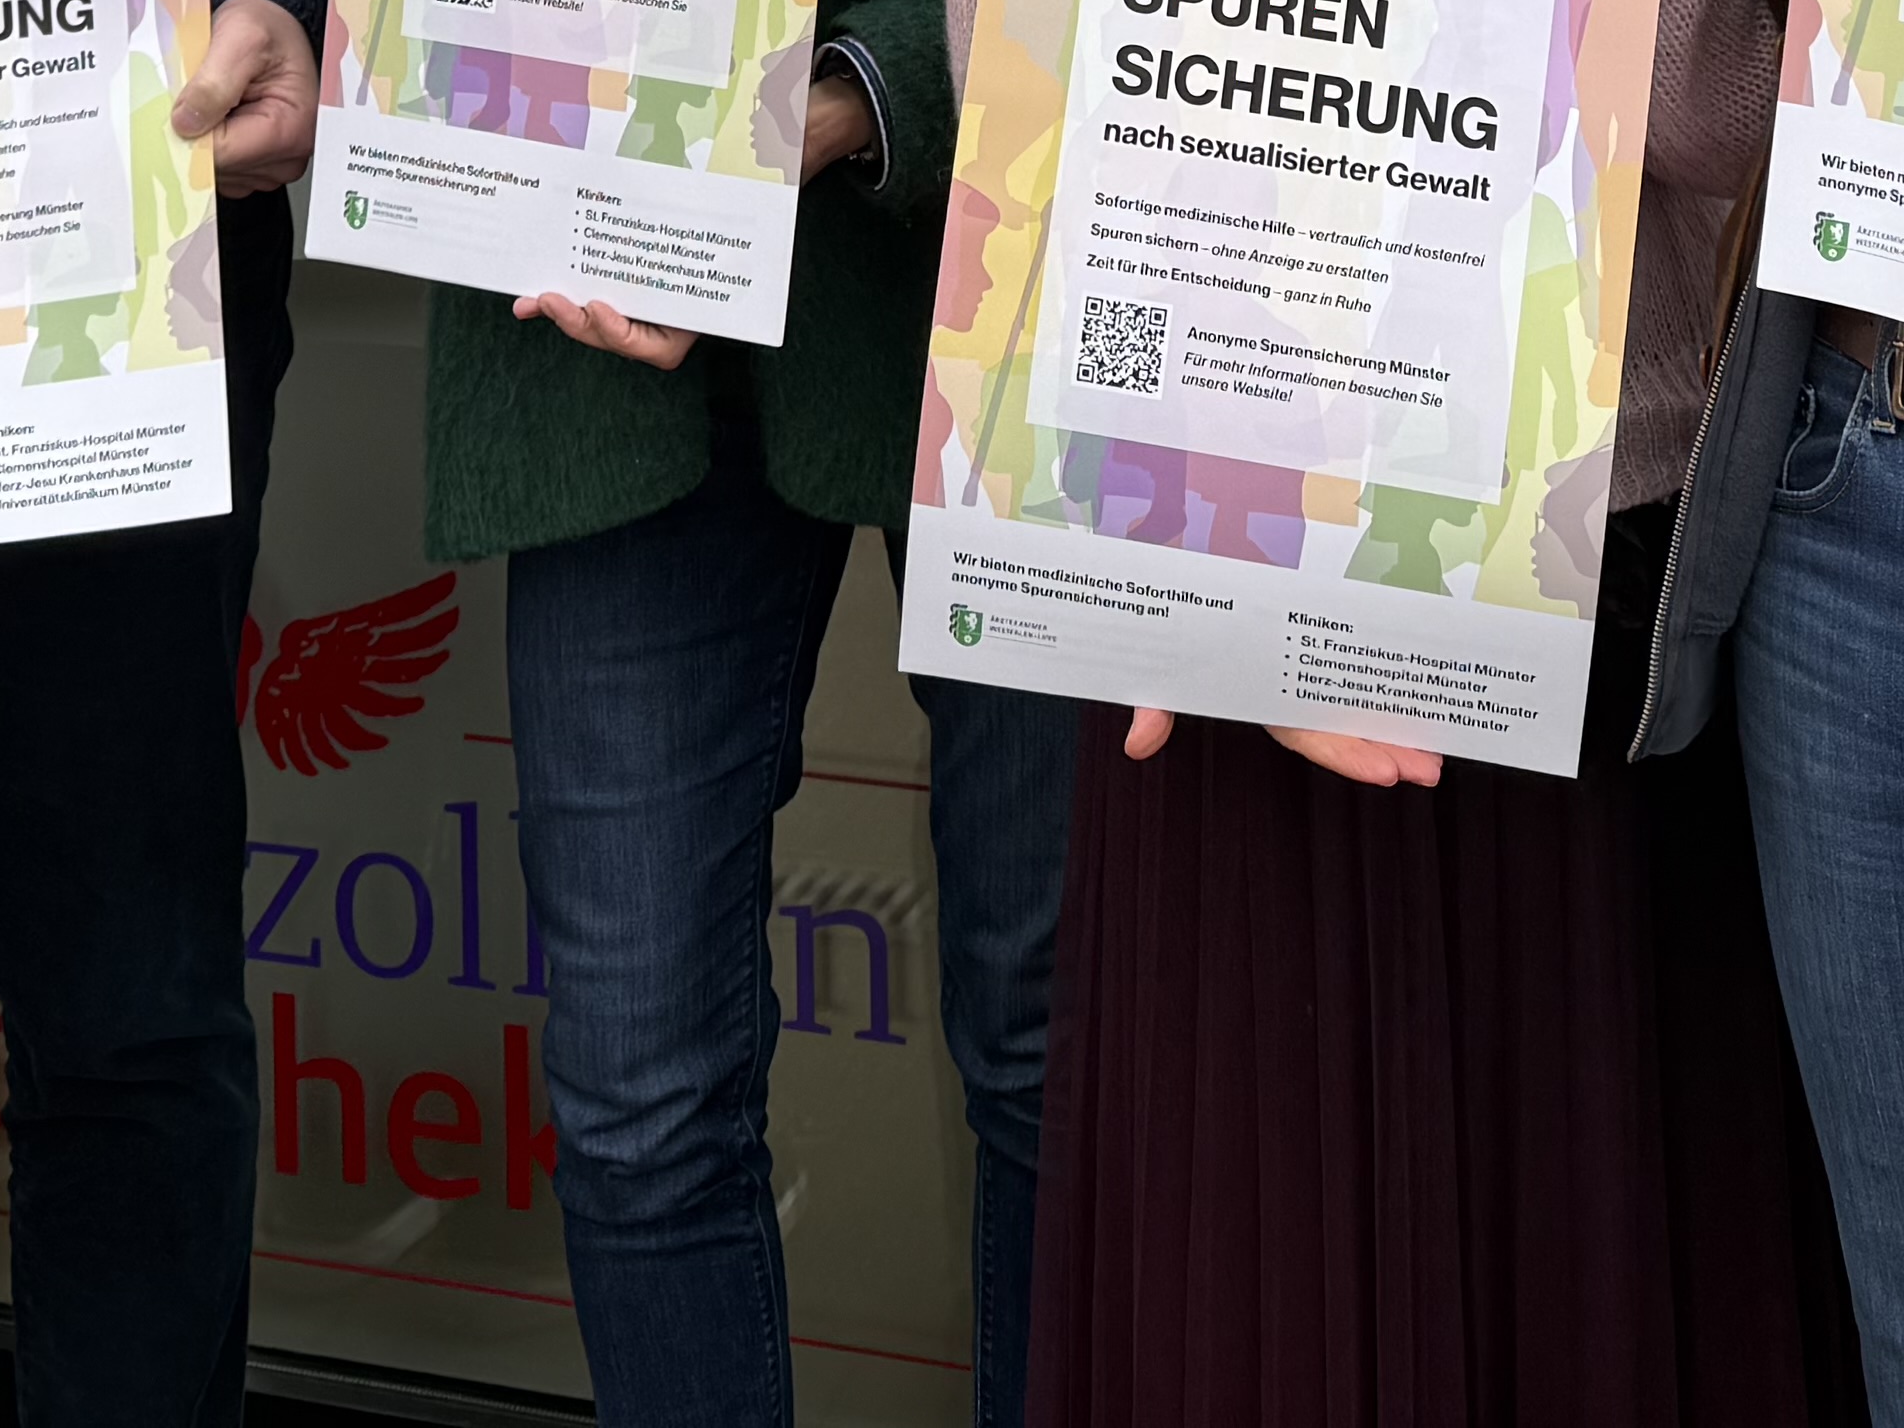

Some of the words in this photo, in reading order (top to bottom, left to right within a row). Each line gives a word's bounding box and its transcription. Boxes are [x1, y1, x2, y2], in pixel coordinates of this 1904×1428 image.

[11, 50, 96, 78] Gewalt
[1111, 44, 1498, 152] SICHERUNG
[1103, 123, 1175, 152] nach
[1179, 135, 1381, 183] sexualisierter
[1385, 161, 1491, 202] Gewalt
[1818, 176, 1888, 200] anonyme
[1821, 153, 1847, 170] Wir
[1849, 158, 1895, 182] bieten
[1094, 192, 1162, 216] Sofortige
[1164, 206, 1260, 231] medizinische
[1262, 219, 1295, 237] Hilfe
[1309, 229, 1383, 251] vertraulich
[1384, 242, 1413, 255] und
[1413, 244, 1486, 267] kostenfrei
[1086, 253, 1114, 271] Zeit
[1117, 259, 1138, 274] für
[1140, 262, 1168, 279] Ihre
[1170, 267, 1271, 299] Entscheidung
[1283, 289, 1318, 304] ganz
[1319, 292, 1333, 306] in
[1334, 295, 1372, 313] Ruhe
[1183, 351, 1208, 367] Für
[1209, 359, 1247, 374] mehr
[1247, 363, 1346, 391] Informationen
[1348, 379, 1418, 404] besuchen
[1420, 391, 1443, 408] Sie
[1187, 326, 1258, 350] Anonyme
[1259, 338, 1387, 375] Spurensicherung
[1389, 359, 1452, 383] Münster
[1181, 374, 1229, 392] unsere
[1233, 380, 1293, 403] Website!
